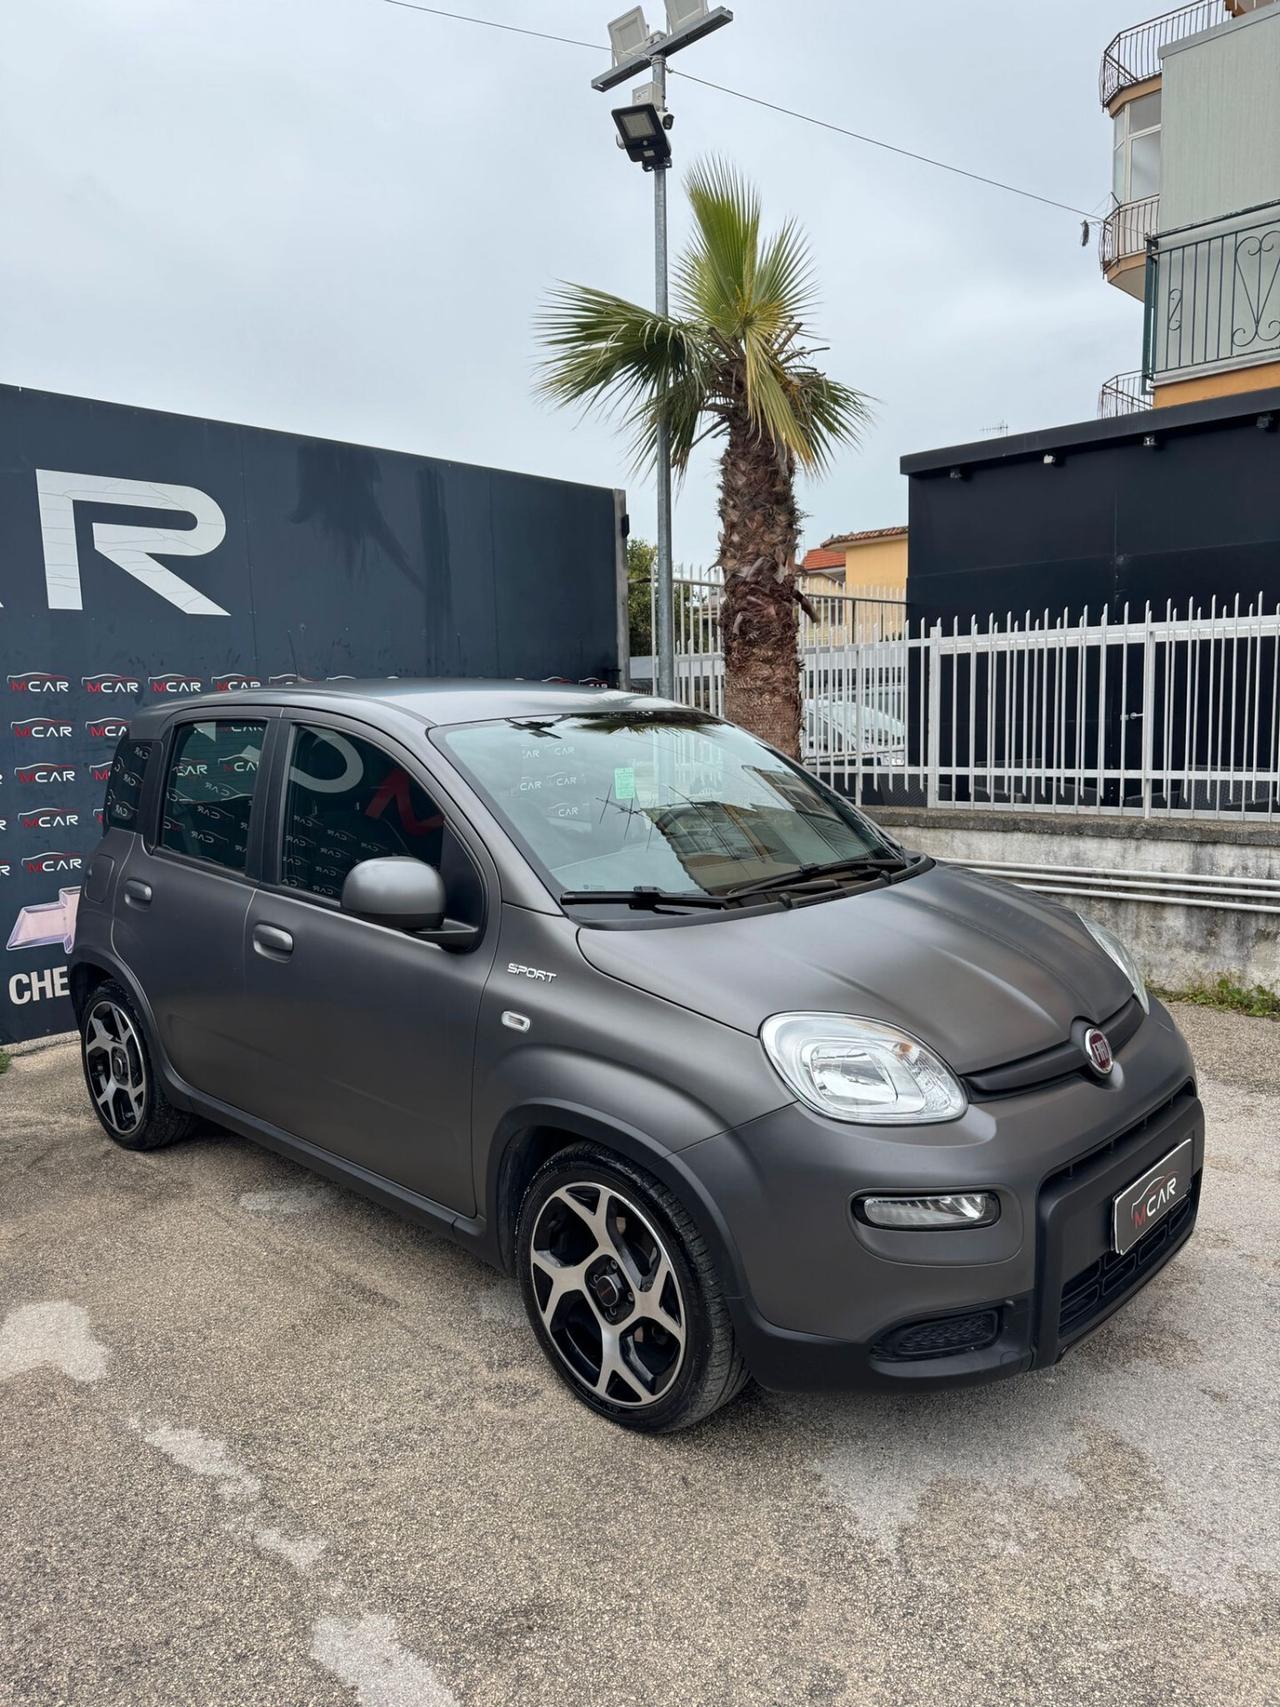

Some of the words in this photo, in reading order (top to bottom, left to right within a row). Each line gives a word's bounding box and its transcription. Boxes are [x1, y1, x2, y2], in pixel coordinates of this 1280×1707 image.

[0, 468, 231, 616] R
[10, 681, 69, 692] MCAR
[86, 682, 139, 693] MCAR
[152, 681, 201, 692] MCAR
[15, 726, 72, 737] MCAR
[89, 726, 127, 737] MCA
[19, 770, 75, 783] MCAR
[23, 814, 79, 828] MCAR
[27, 858, 82, 872] MCAR
[507, 962, 557, 982] SPORT
[1132, 1177, 1177, 1229] MCAR
